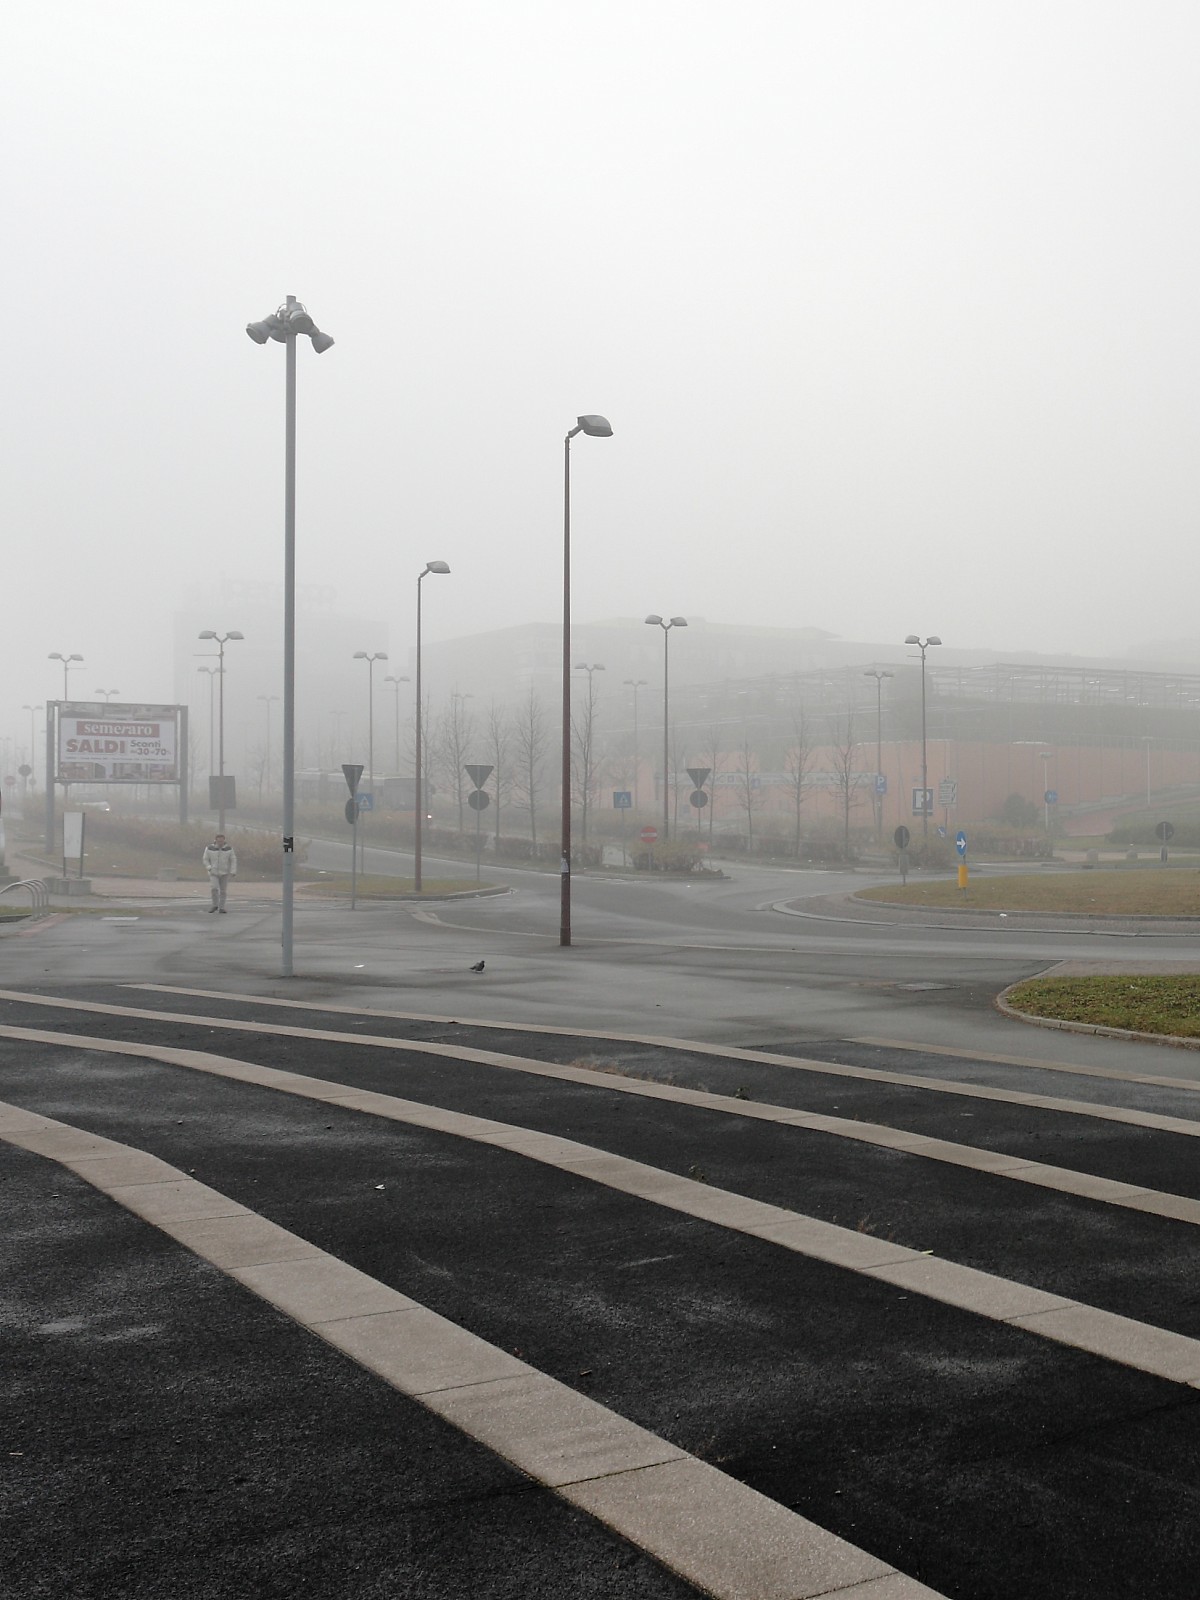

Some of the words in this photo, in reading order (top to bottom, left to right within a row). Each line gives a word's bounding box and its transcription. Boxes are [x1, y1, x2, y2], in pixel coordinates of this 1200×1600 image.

[84, 723, 153, 735] semeraro
[66, 739, 125, 753] SALDI
[130, 740, 161, 748] Sconti
[915, 790, 930, 808] P
